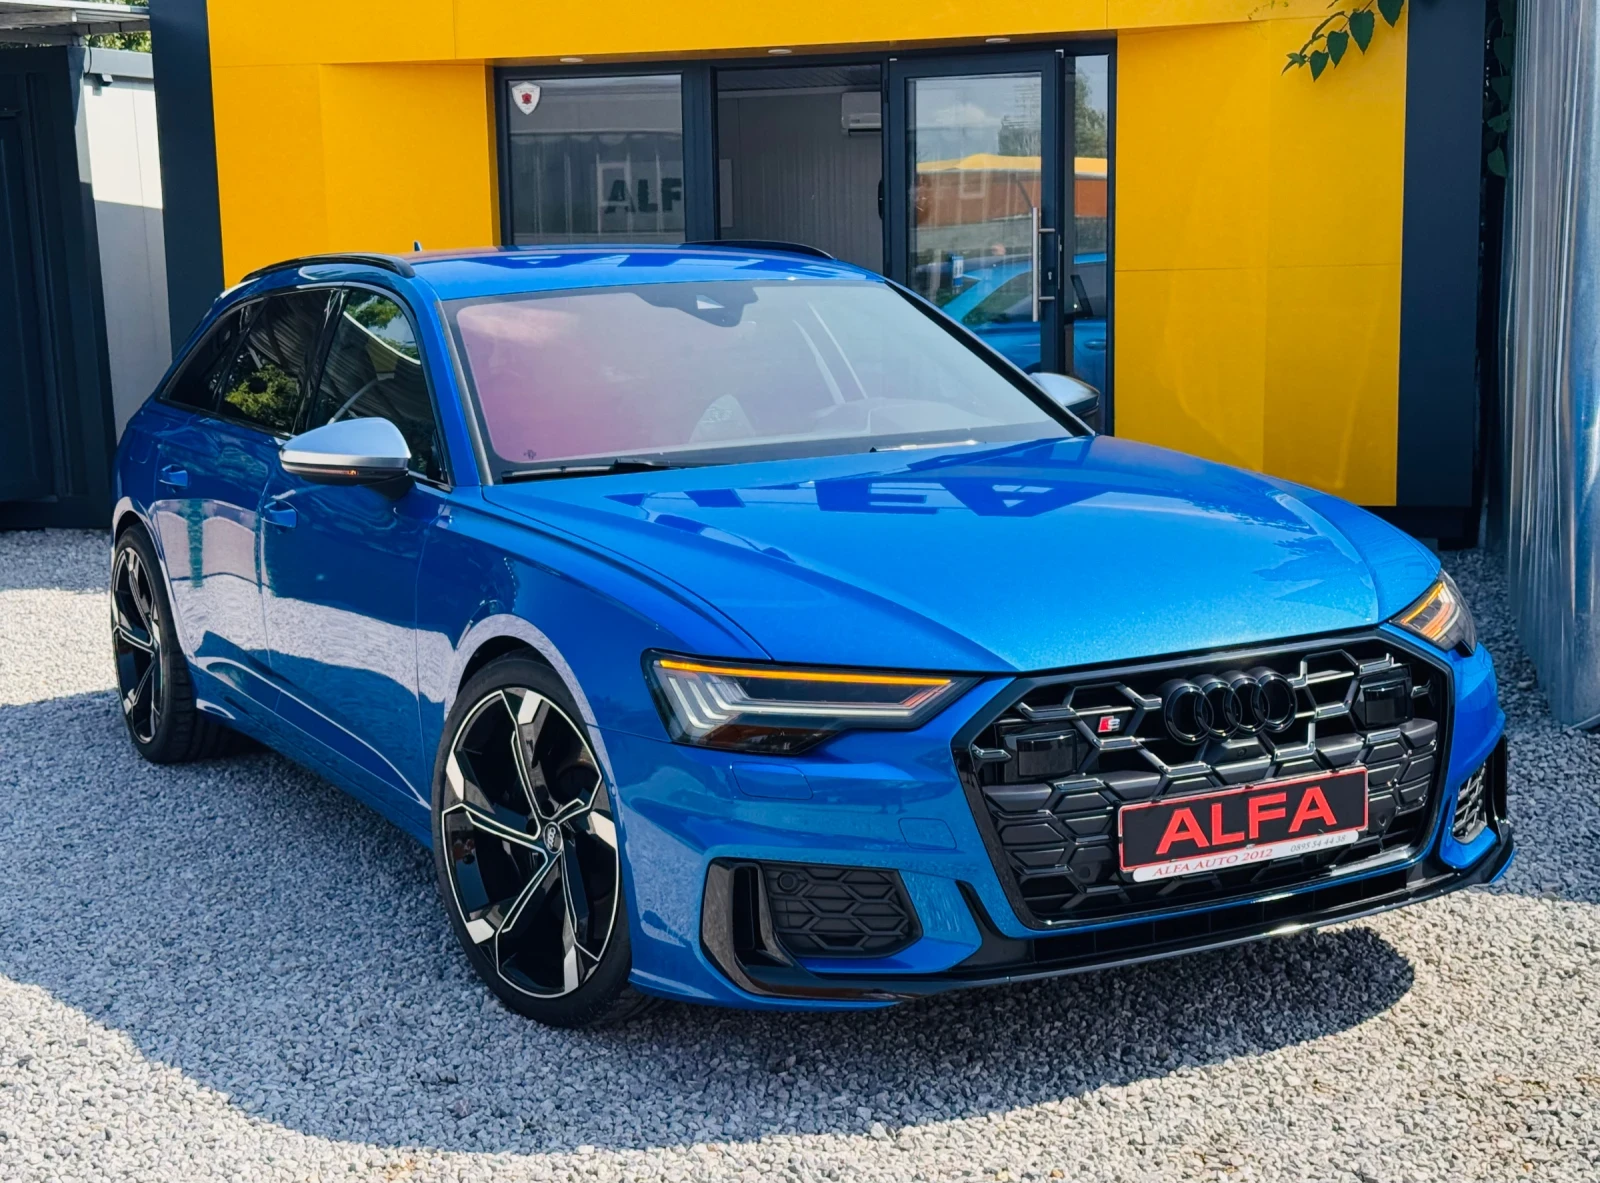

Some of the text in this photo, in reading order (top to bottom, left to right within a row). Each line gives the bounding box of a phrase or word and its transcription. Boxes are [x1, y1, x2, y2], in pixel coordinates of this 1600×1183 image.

[1155, 786, 1337, 855] ALFA
[1151, 848, 1273, 877] ALFA AUTO 2012
